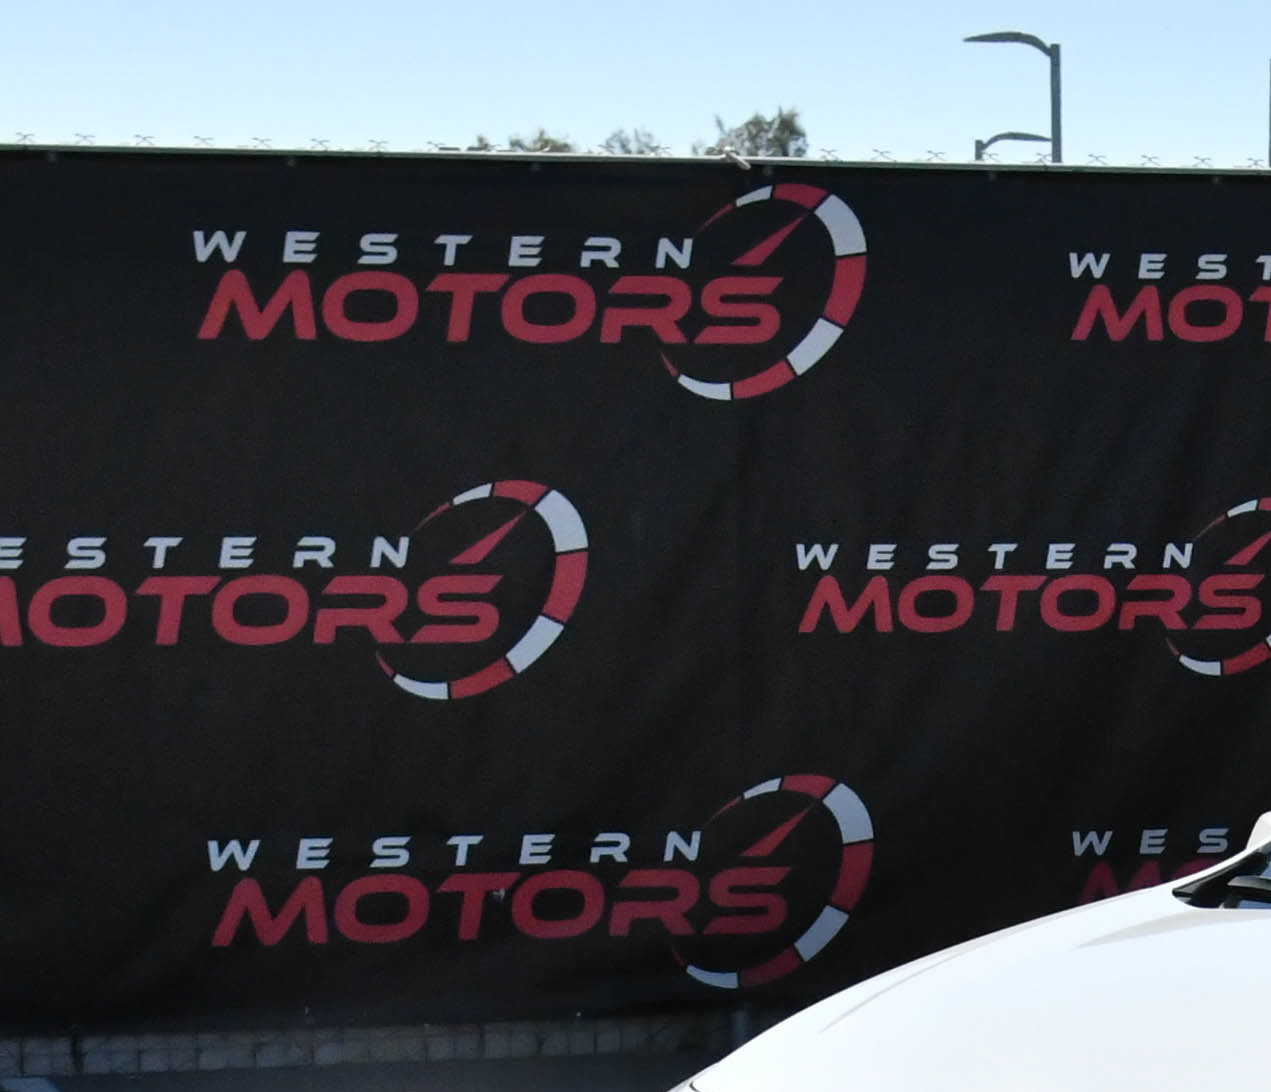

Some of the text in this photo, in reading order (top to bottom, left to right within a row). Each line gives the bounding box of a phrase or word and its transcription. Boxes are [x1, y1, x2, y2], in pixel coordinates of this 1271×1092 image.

[193, 230, 693, 269] WESTERN
[198, 269, 783, 344] MOTORS
[796, 542, 1193, 571] WESTERN
[799, 573, 1264, 633] MOTORS
[207, 831, 701, 871] WESTERN
[213, 867, 789, 948] MOTORS
